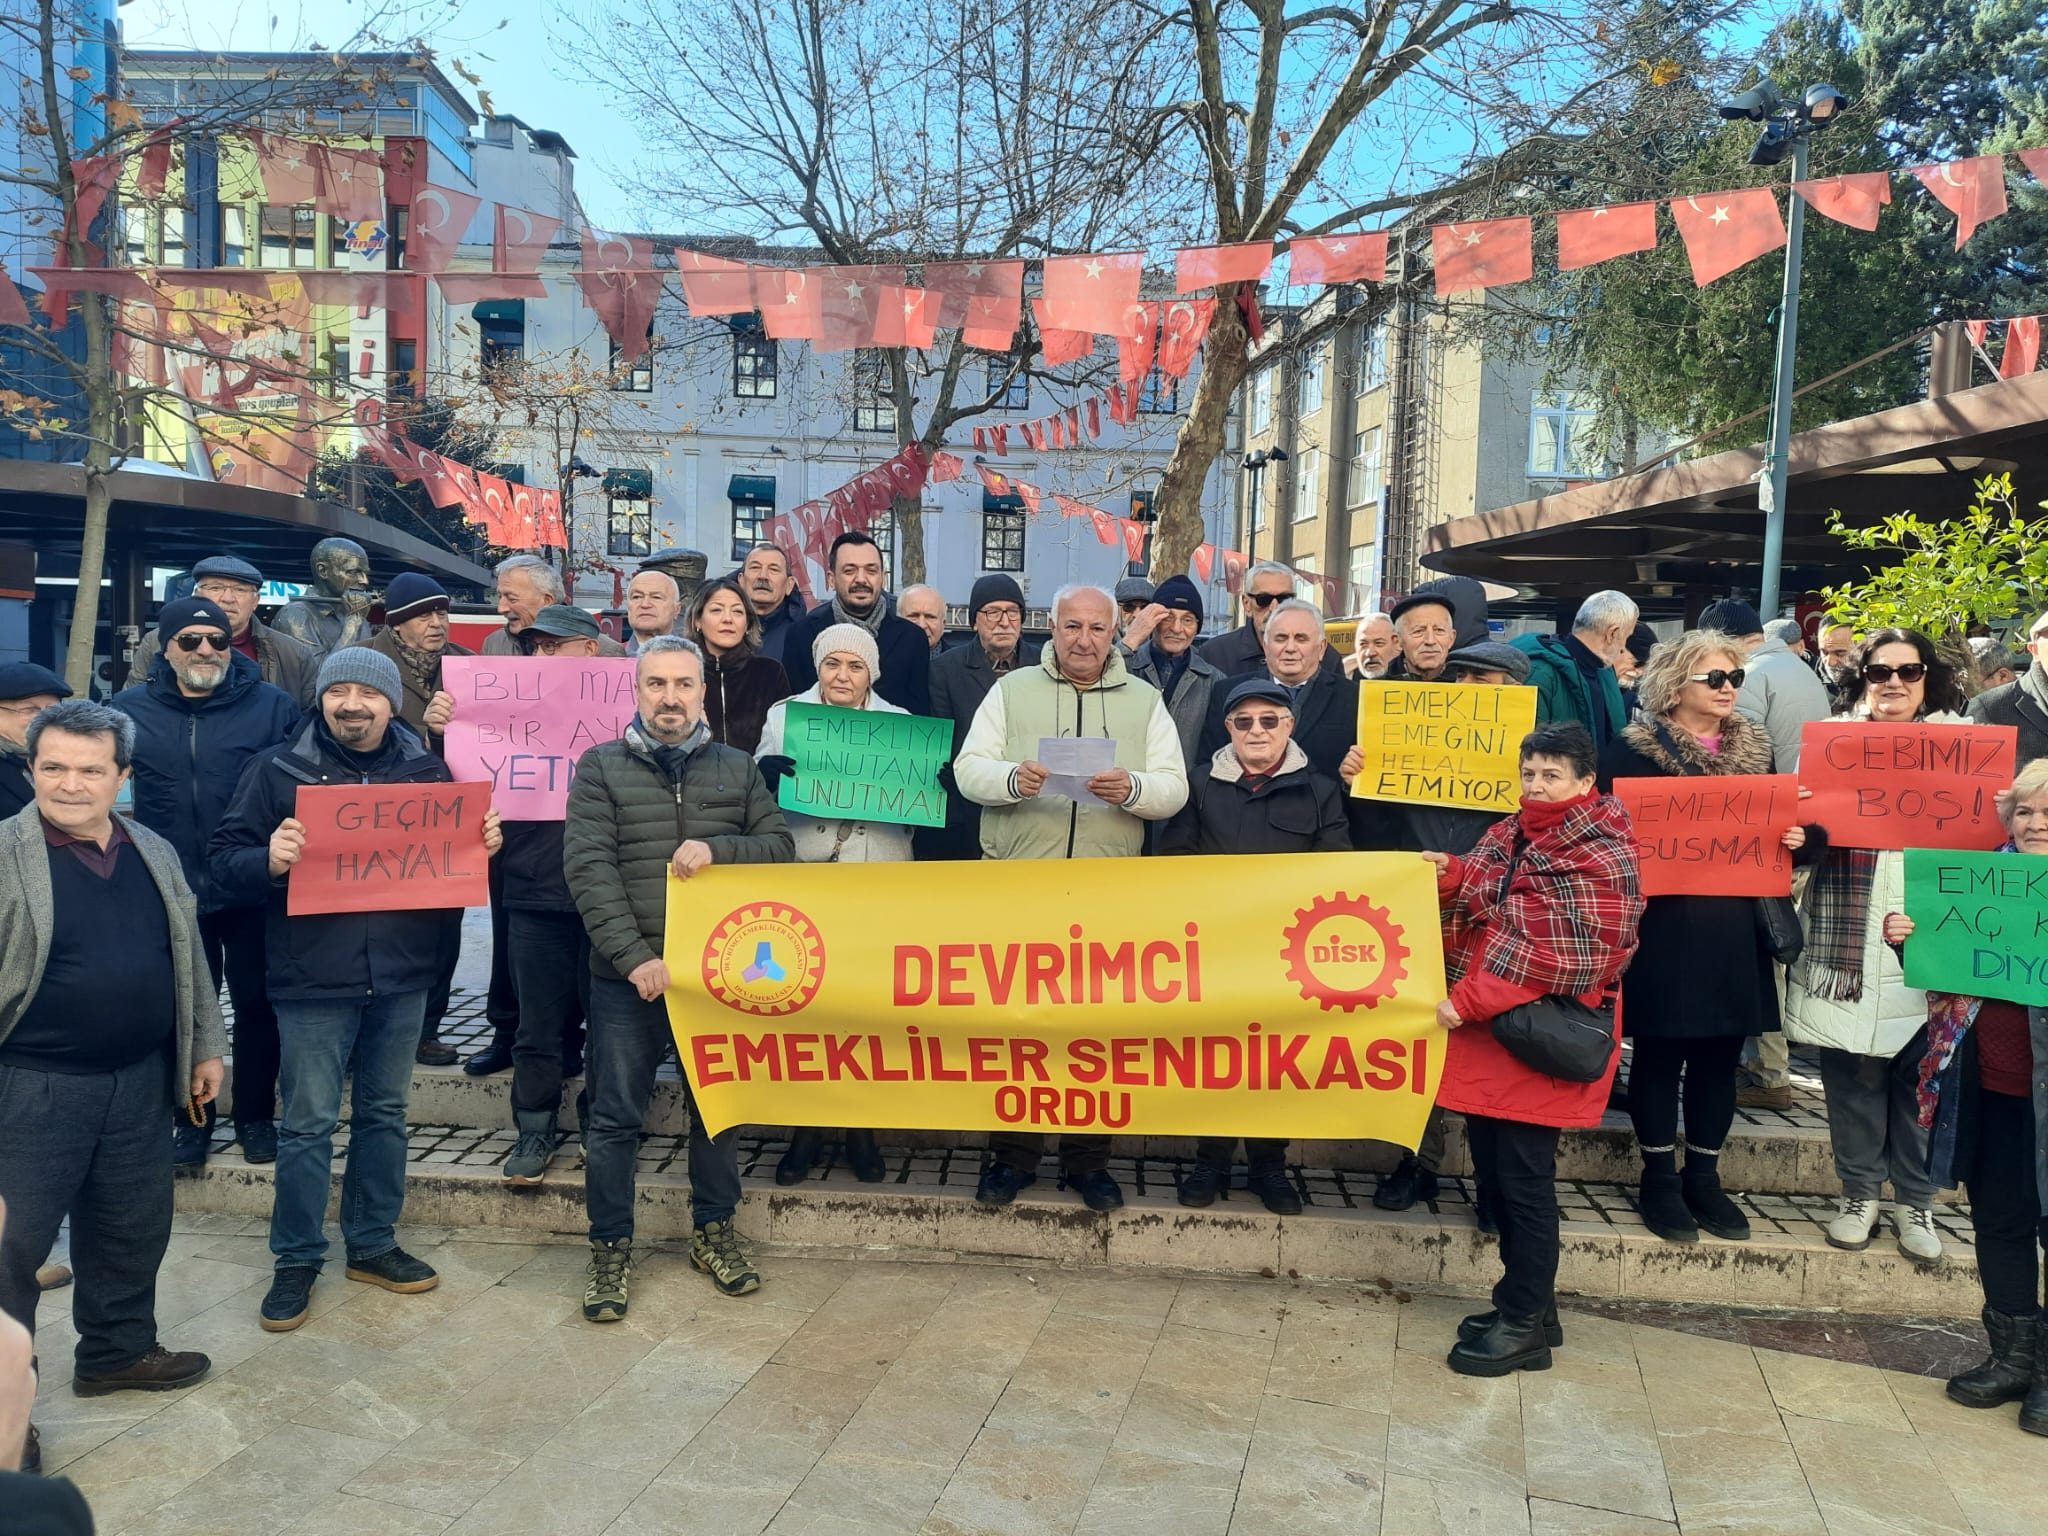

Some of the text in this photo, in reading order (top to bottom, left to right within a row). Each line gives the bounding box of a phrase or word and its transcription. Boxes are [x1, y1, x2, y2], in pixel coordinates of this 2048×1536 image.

[475, 672, 542, 700] BU
[1382, 687, 1504, 723] EMEKLİ
[478, 715, 547, 748] BİR
[1382, 722, 1508, 755] EMEĞİNİ
[1382, 752, 1472, 775] HELAL
[1825, 731, 2006, 778] CEBİMİZ
[795, 777, 944, 821] UNUTMA!
[1376, 772, 1515, 806] ETMİYOR
[1637, 785, 1778, 827] EMEKLİ
[336, 791, 464, 833] GEÇİM
[1936, 905, 2002, 943] AÇ
[893, 922, 1202, 1006] DEVRİMCİ
[1311, 934, 1378, 963] DİSK
[690, 1022, 1428, 1096] EMEKLİLER SENDİKASI
[994, 1085, 1132, 1129] ORDU
